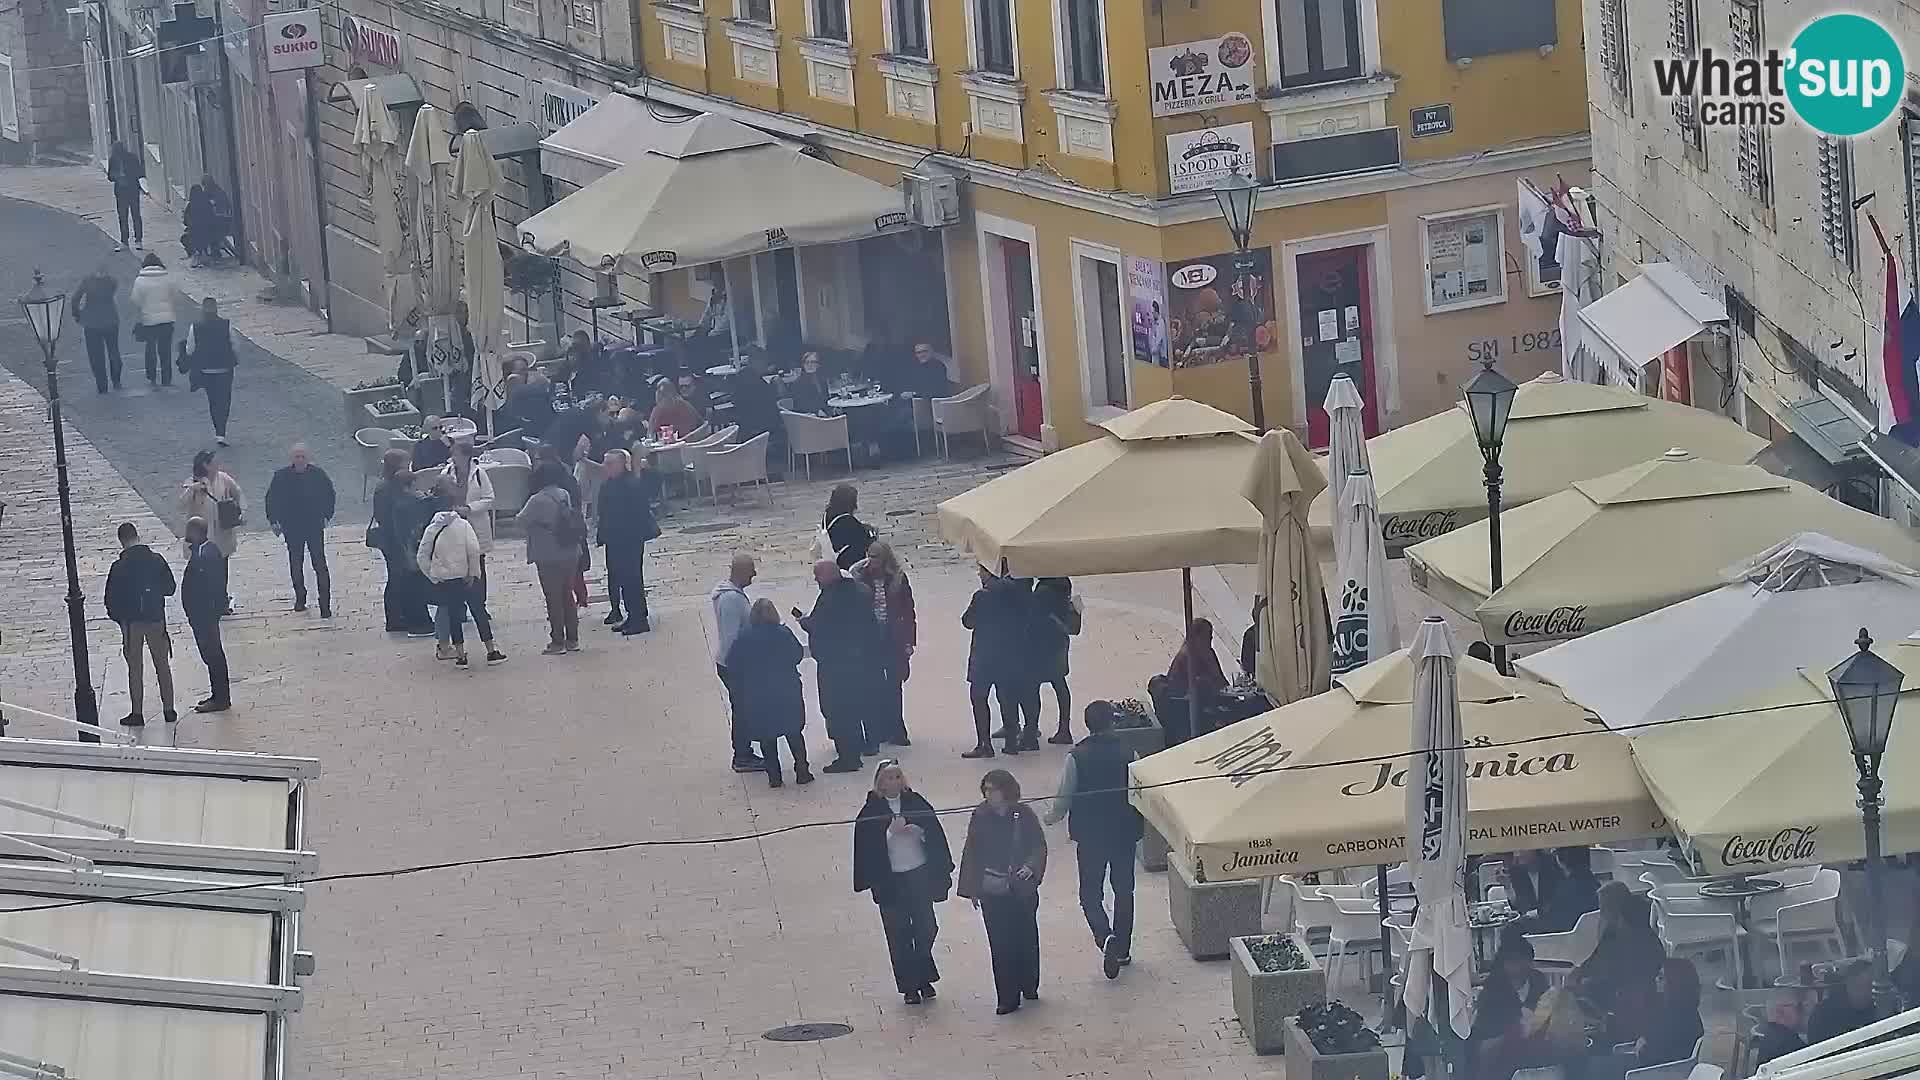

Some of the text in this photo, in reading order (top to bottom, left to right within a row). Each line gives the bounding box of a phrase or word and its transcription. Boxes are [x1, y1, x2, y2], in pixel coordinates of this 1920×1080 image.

[273, 40, 318, 54] SUKNO
[360, 25, 399, 65] SUKNO
[1155, 72, 1234, 102] MEZA
[1164, 98, 1197, 111] PIZZERIA
[1204, 93, 1226, 105] GRILL
[1172, 157, 1219, 176] ISPOD
[1468, 329, 1562, 360] SM 1982
[1505, 604, 1588, 637] Coca-Cola
[1501, 820, 1566, 838] MINERAL
[1569, 814, 1621, 831] WATER
[1248, 838, 1273, 849] 1828
[1721, 825, 1821, 867] Coca-Cola
[1222, 849, 1300, 873] Jamnica
